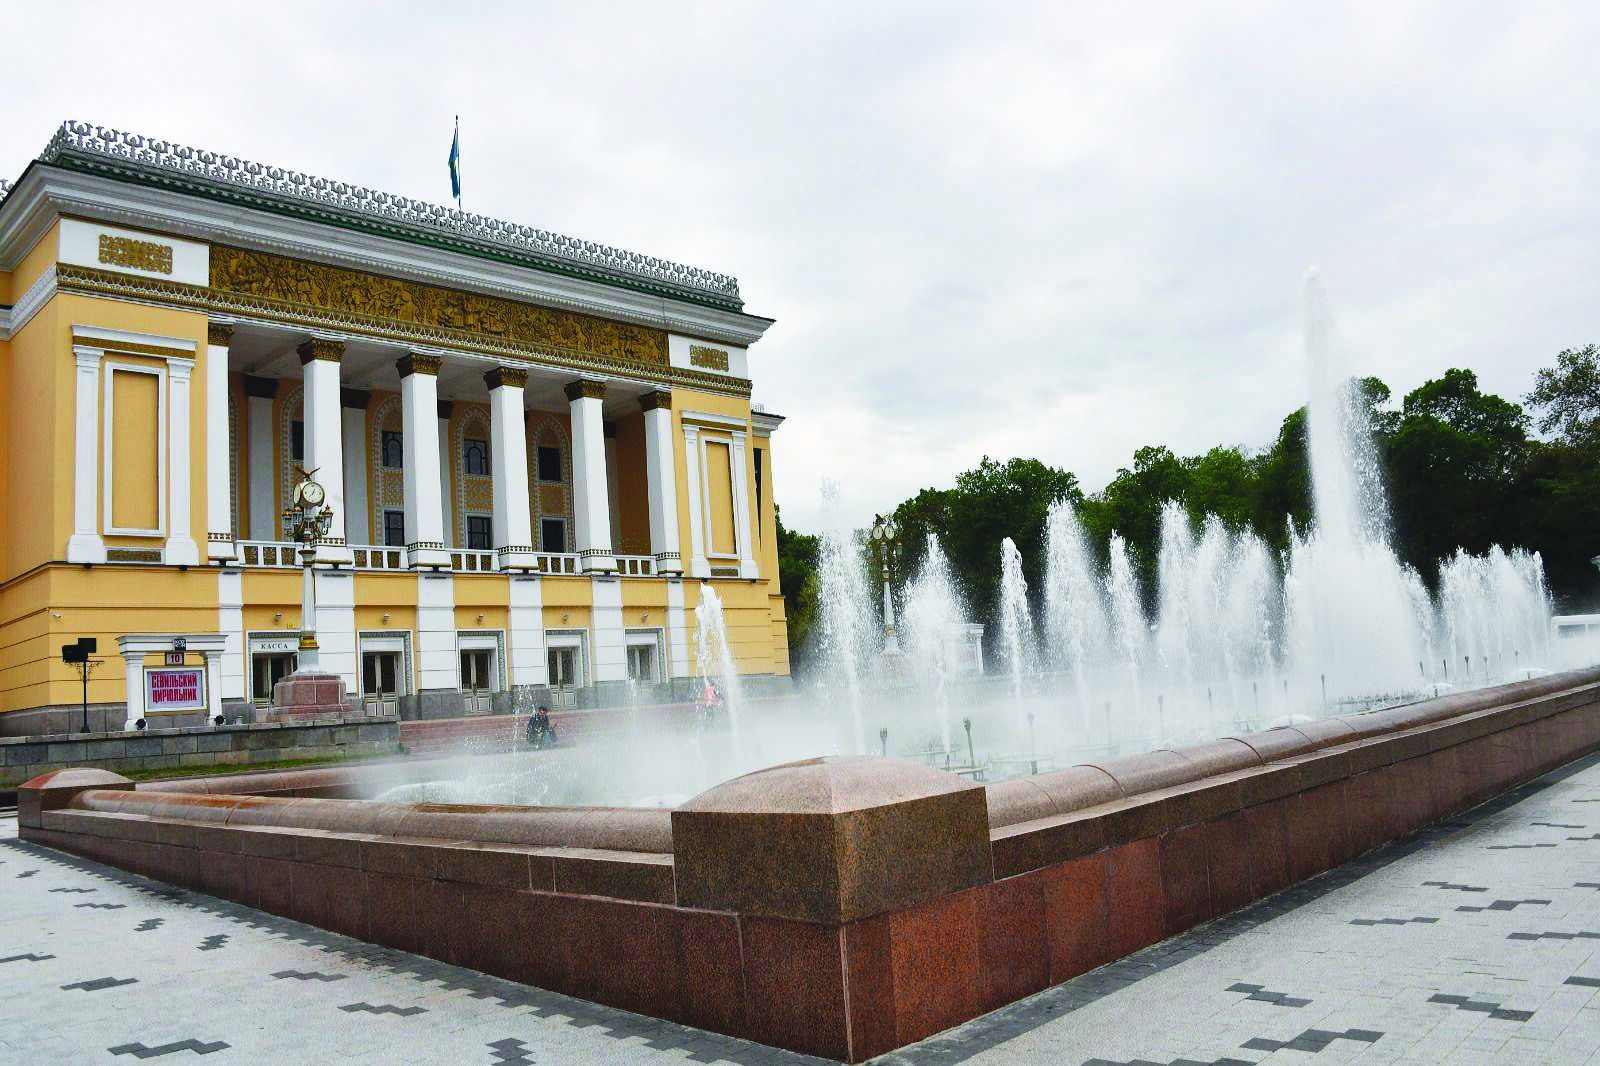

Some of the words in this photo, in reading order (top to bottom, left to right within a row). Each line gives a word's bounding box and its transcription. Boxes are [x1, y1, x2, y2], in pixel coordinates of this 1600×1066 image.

[171, 654, 180, 663] 10
[151, 673, 197, 688] СЕВИЛЬСКИЙ
[152, 688, 197, 704] ЦИРЮЛЬНИК
